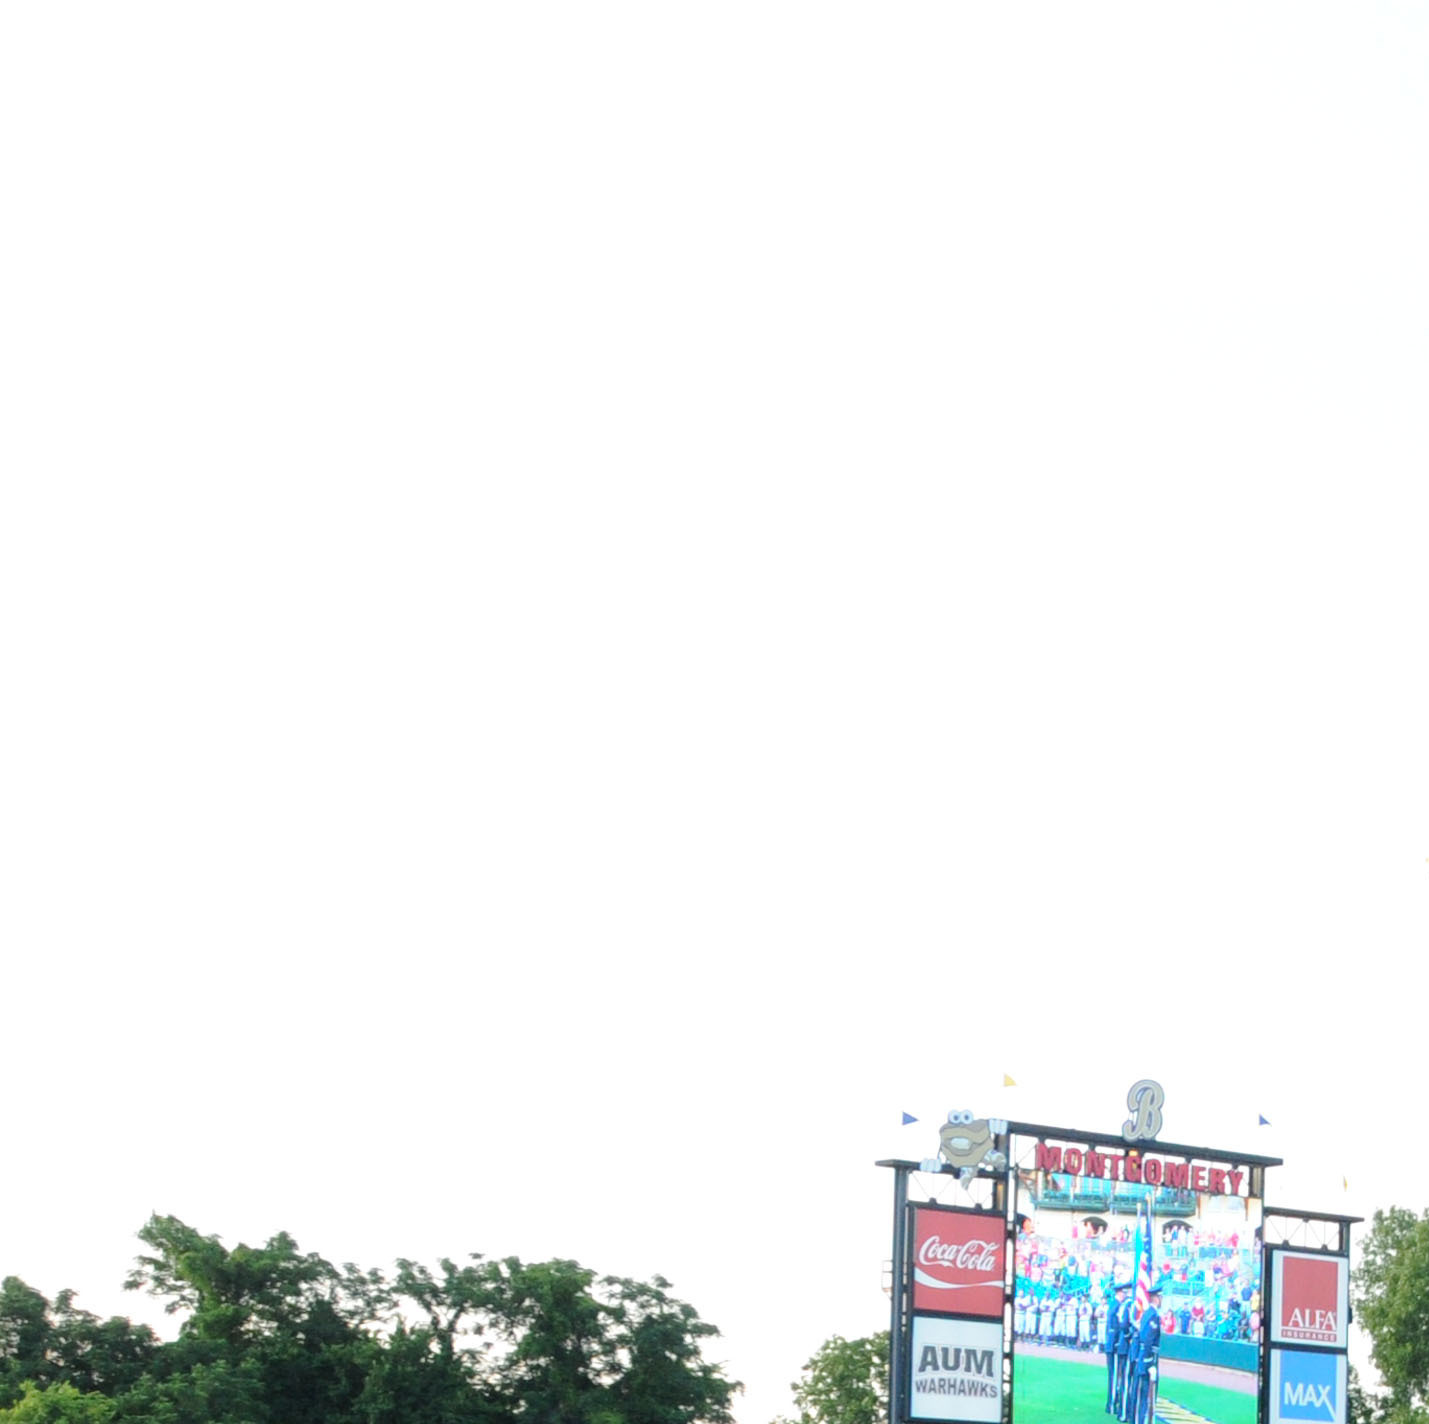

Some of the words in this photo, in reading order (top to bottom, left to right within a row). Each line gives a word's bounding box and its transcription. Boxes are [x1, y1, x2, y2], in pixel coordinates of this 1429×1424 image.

[1122, 1080, 1165, 1142] B
[1035, 1142, 1243, 1195] MONTGOMERY
[919, 1236, 999, 1271] Coca-Cola
[1288, 1308, 1336, 1331] ALFA
[918, 1346, 994, 1377] AUM
[915, 1378, 998, 1398] WARHAWKS
[1284, 1382, 1335, 1416] MAX
